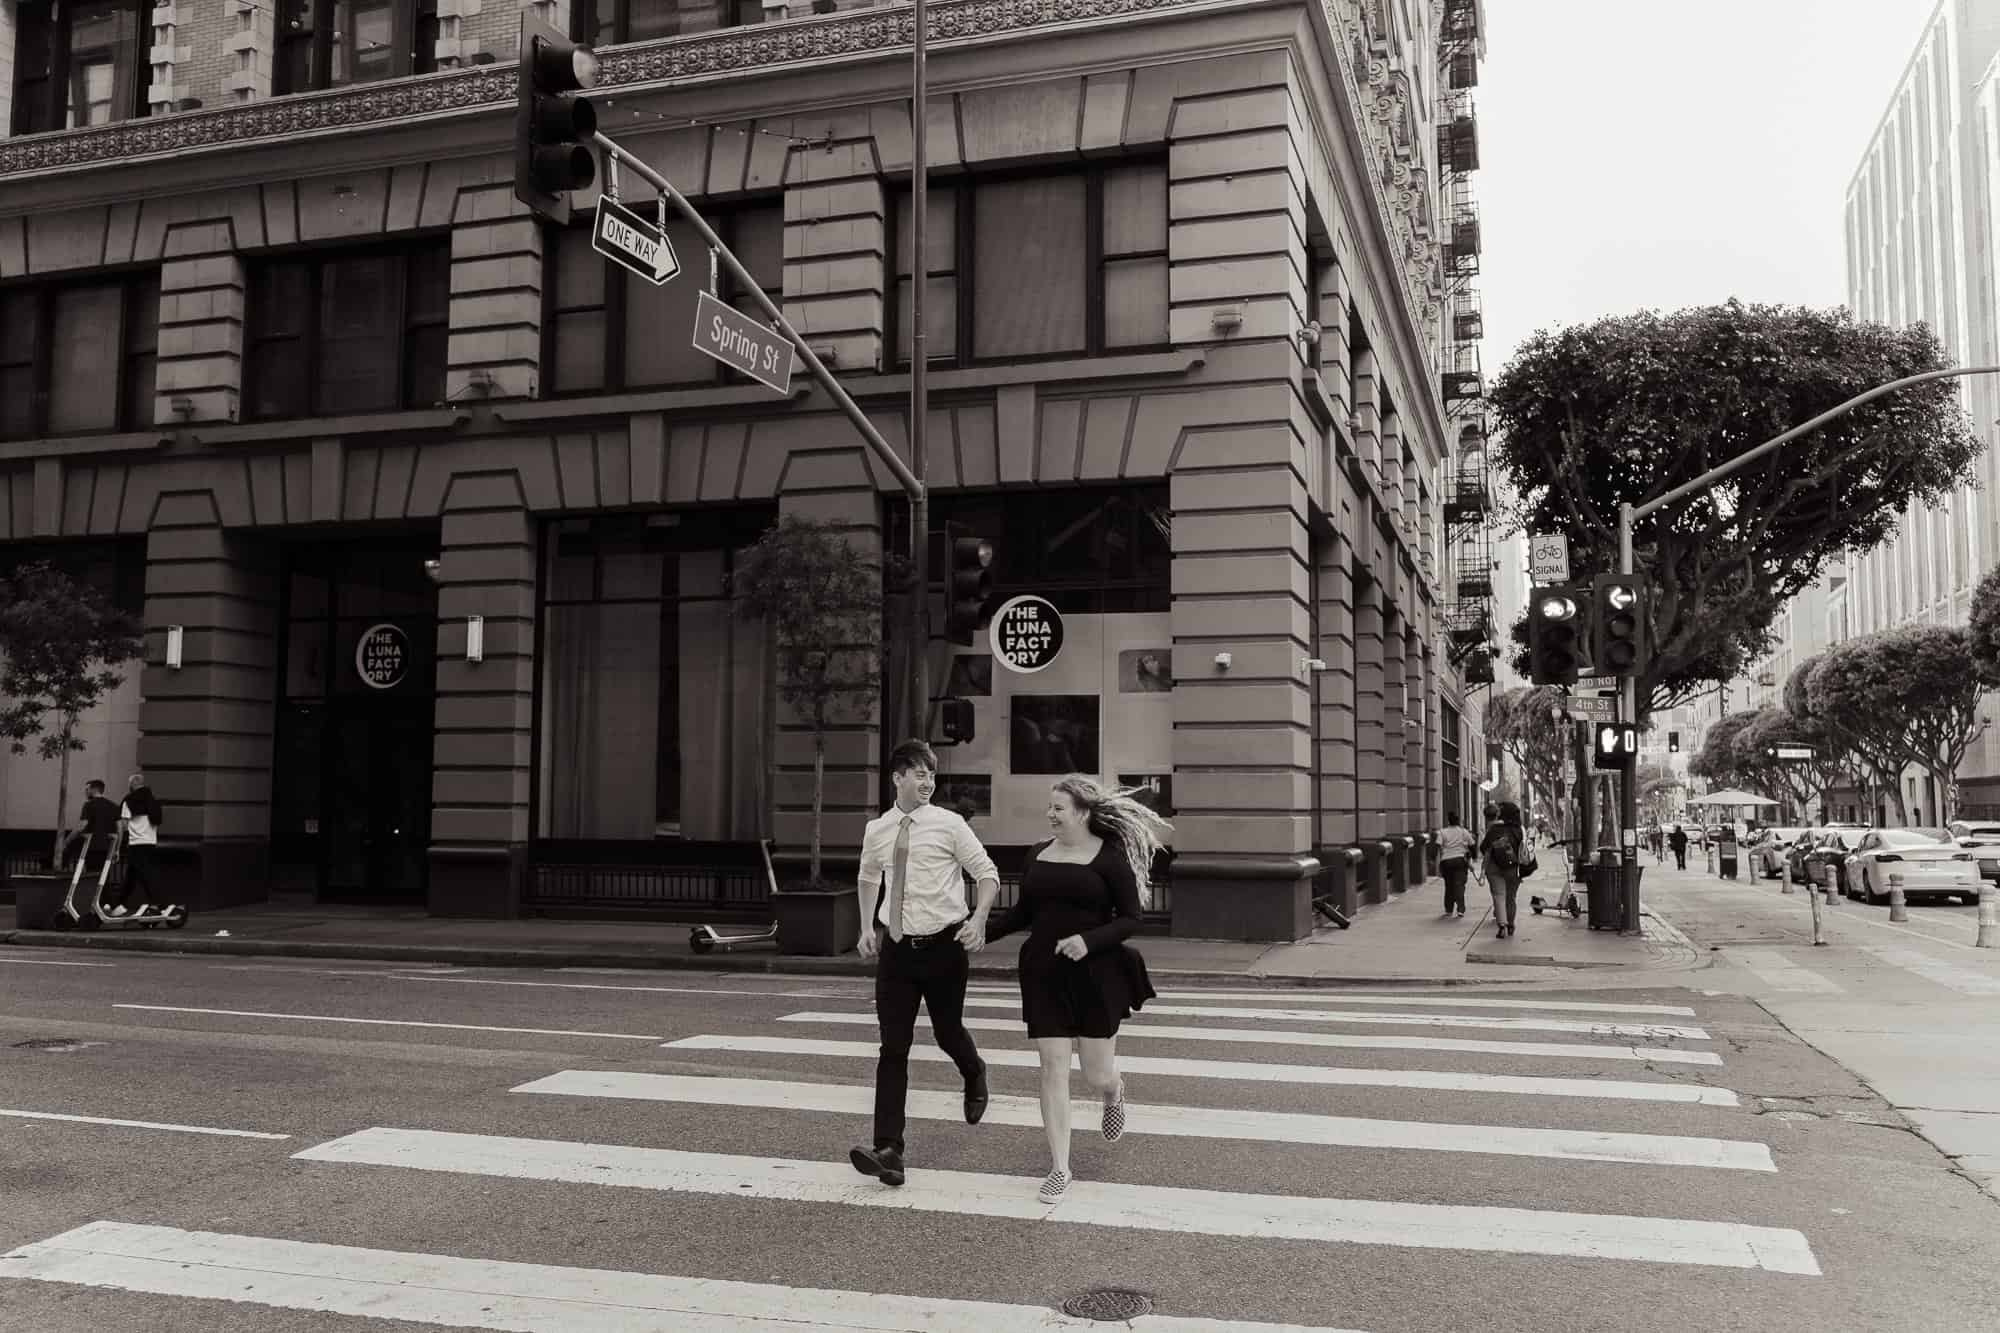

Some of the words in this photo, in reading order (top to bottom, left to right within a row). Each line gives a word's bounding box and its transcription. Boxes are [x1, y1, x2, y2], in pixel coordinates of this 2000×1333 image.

[607, 219, 632, 249] ONE
[635, 234, 658, 264] WAY
[711, 315, 758, 370] Spring
[763, 344, 780, 374] St
[1535, 564, 1566, 575] SIGNAL
[1006, 606, 1038, 619] THE
[1006, 621, 1051, 635] LUNA
[368, 633, 393, 644] THE
[1006, 636, 1051, 650] FACT
[368, 645, 401, 657] LUNA
[368, 658, 401, 669] FACT
[1006, 651, 1040, 665] ORY
[367, 670, 392, 681] ORY
[1575, 698, 1593, 710] 4th
[1598, 699, 1609, 710] St
[1624, 730, 1635, 752] 0
